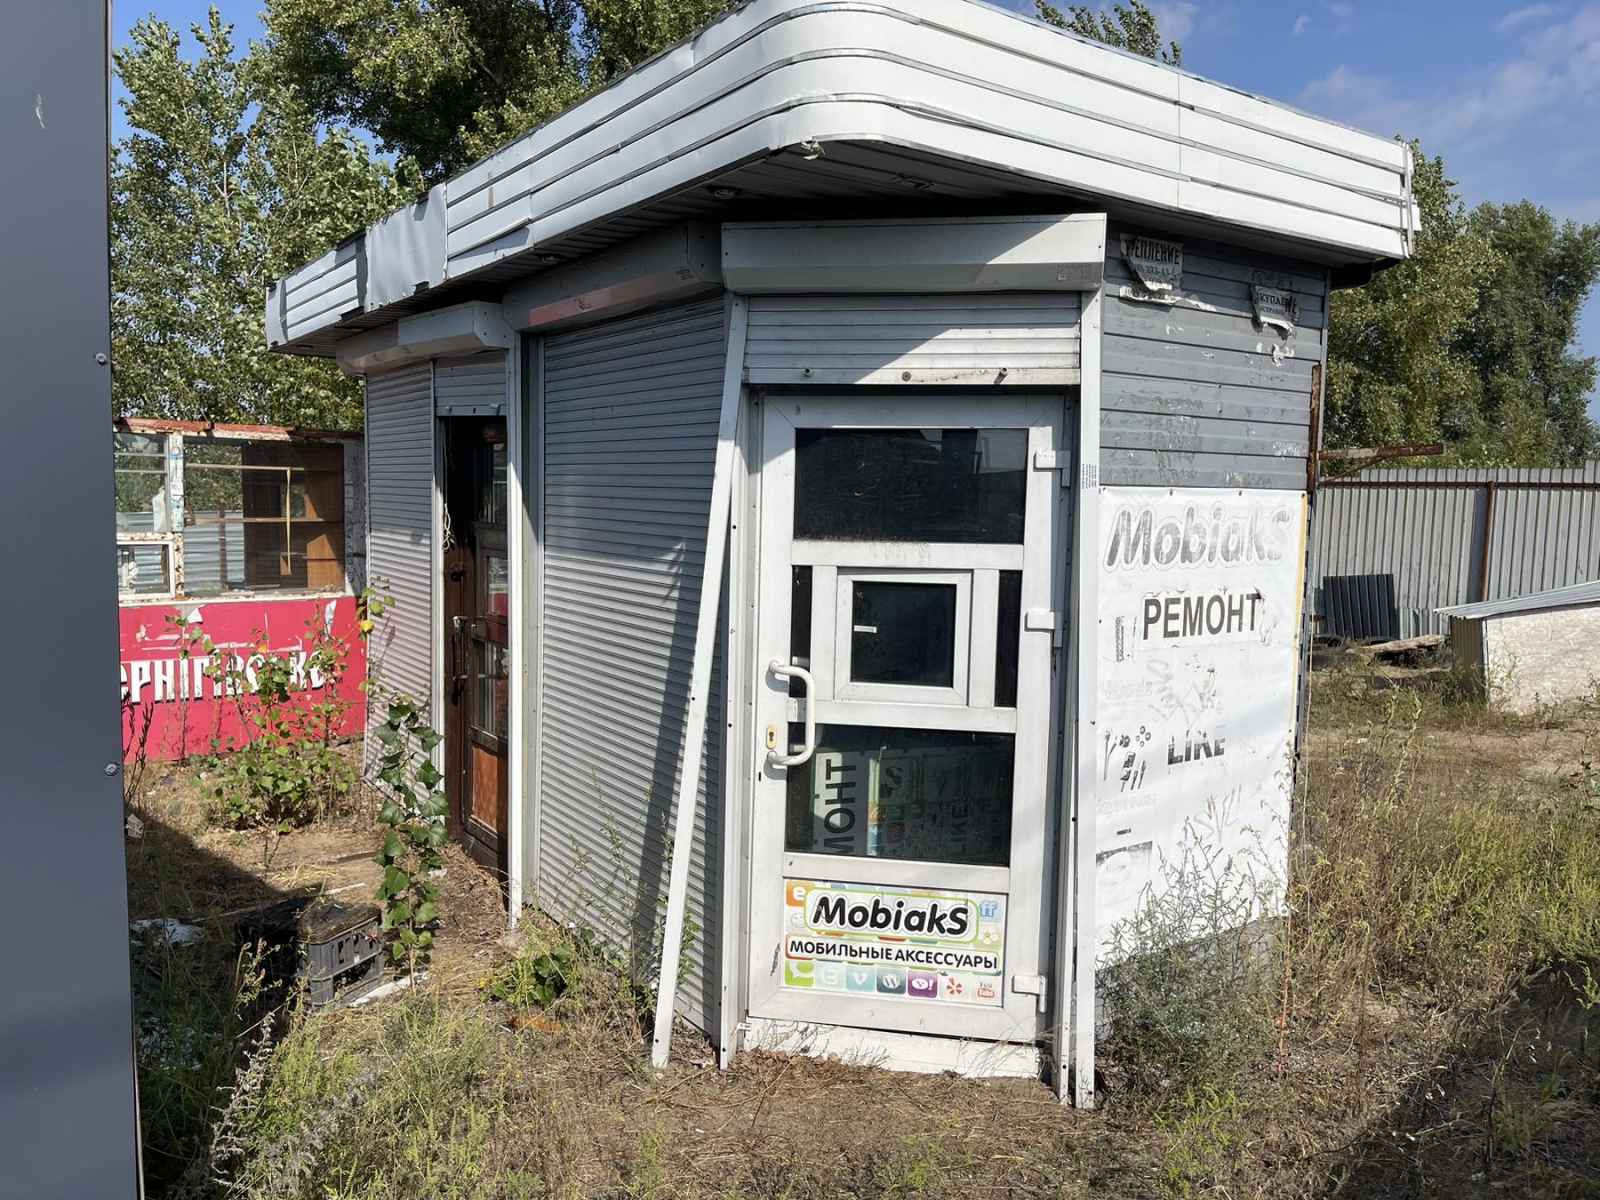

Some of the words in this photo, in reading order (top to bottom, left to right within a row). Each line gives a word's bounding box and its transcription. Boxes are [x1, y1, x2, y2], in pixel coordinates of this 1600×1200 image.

[1142, 592, 1262, 641] РЕМОНТ
[812, 896, 969, 936] MobiakS
[789, 940, 896, 961] МОБИЛЬНЫЕ
[895, 946, 998, 970] АКСЕССУАРЫ
